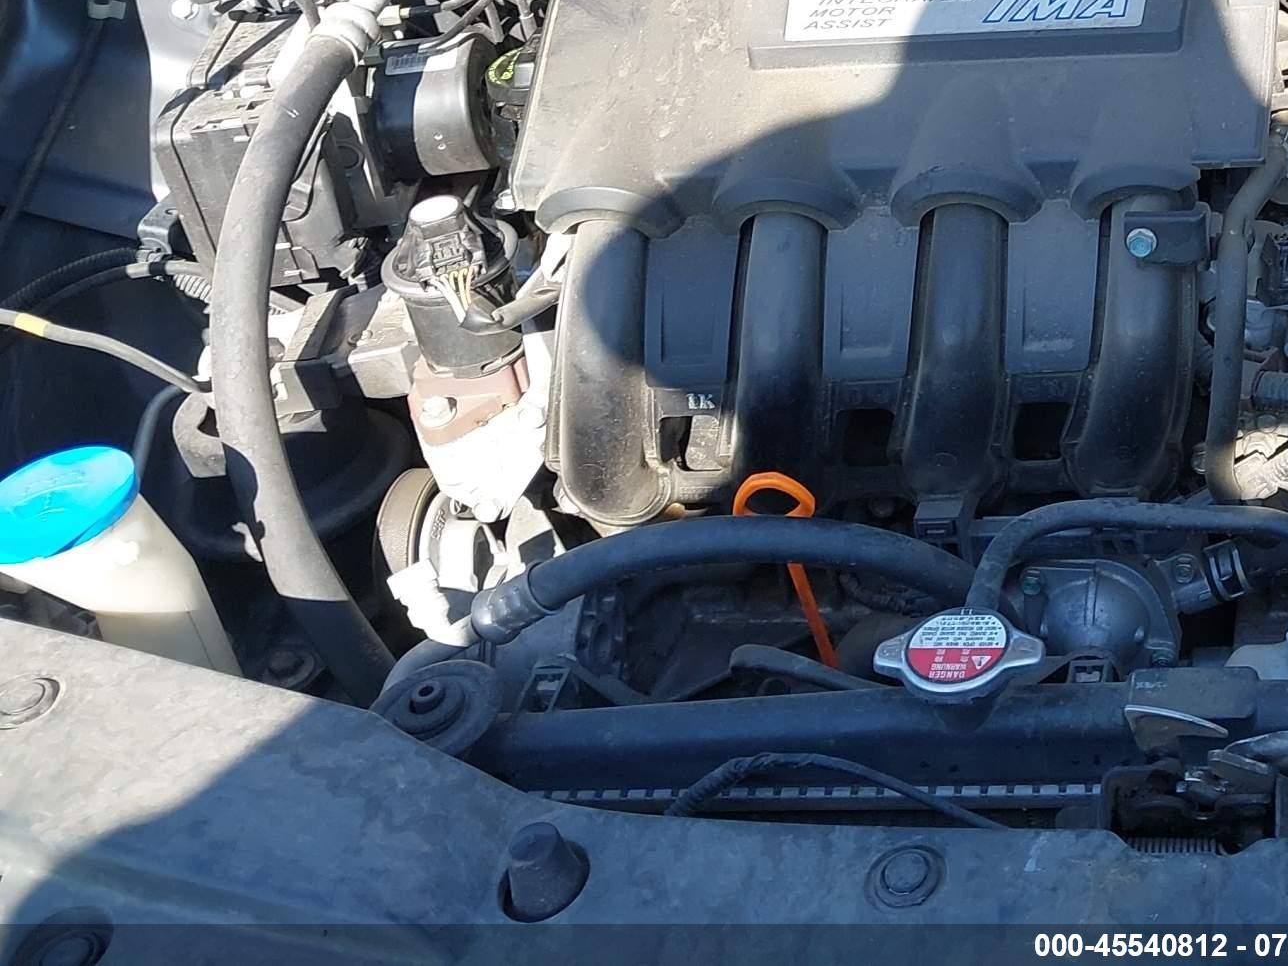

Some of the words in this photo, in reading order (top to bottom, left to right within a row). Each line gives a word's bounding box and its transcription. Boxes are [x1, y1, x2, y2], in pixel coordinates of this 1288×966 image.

[808, 6, 897, 18] MOTOR
[803, 17, 891, 31] ASSIST
[928, 671, 966, 679] DANGER
